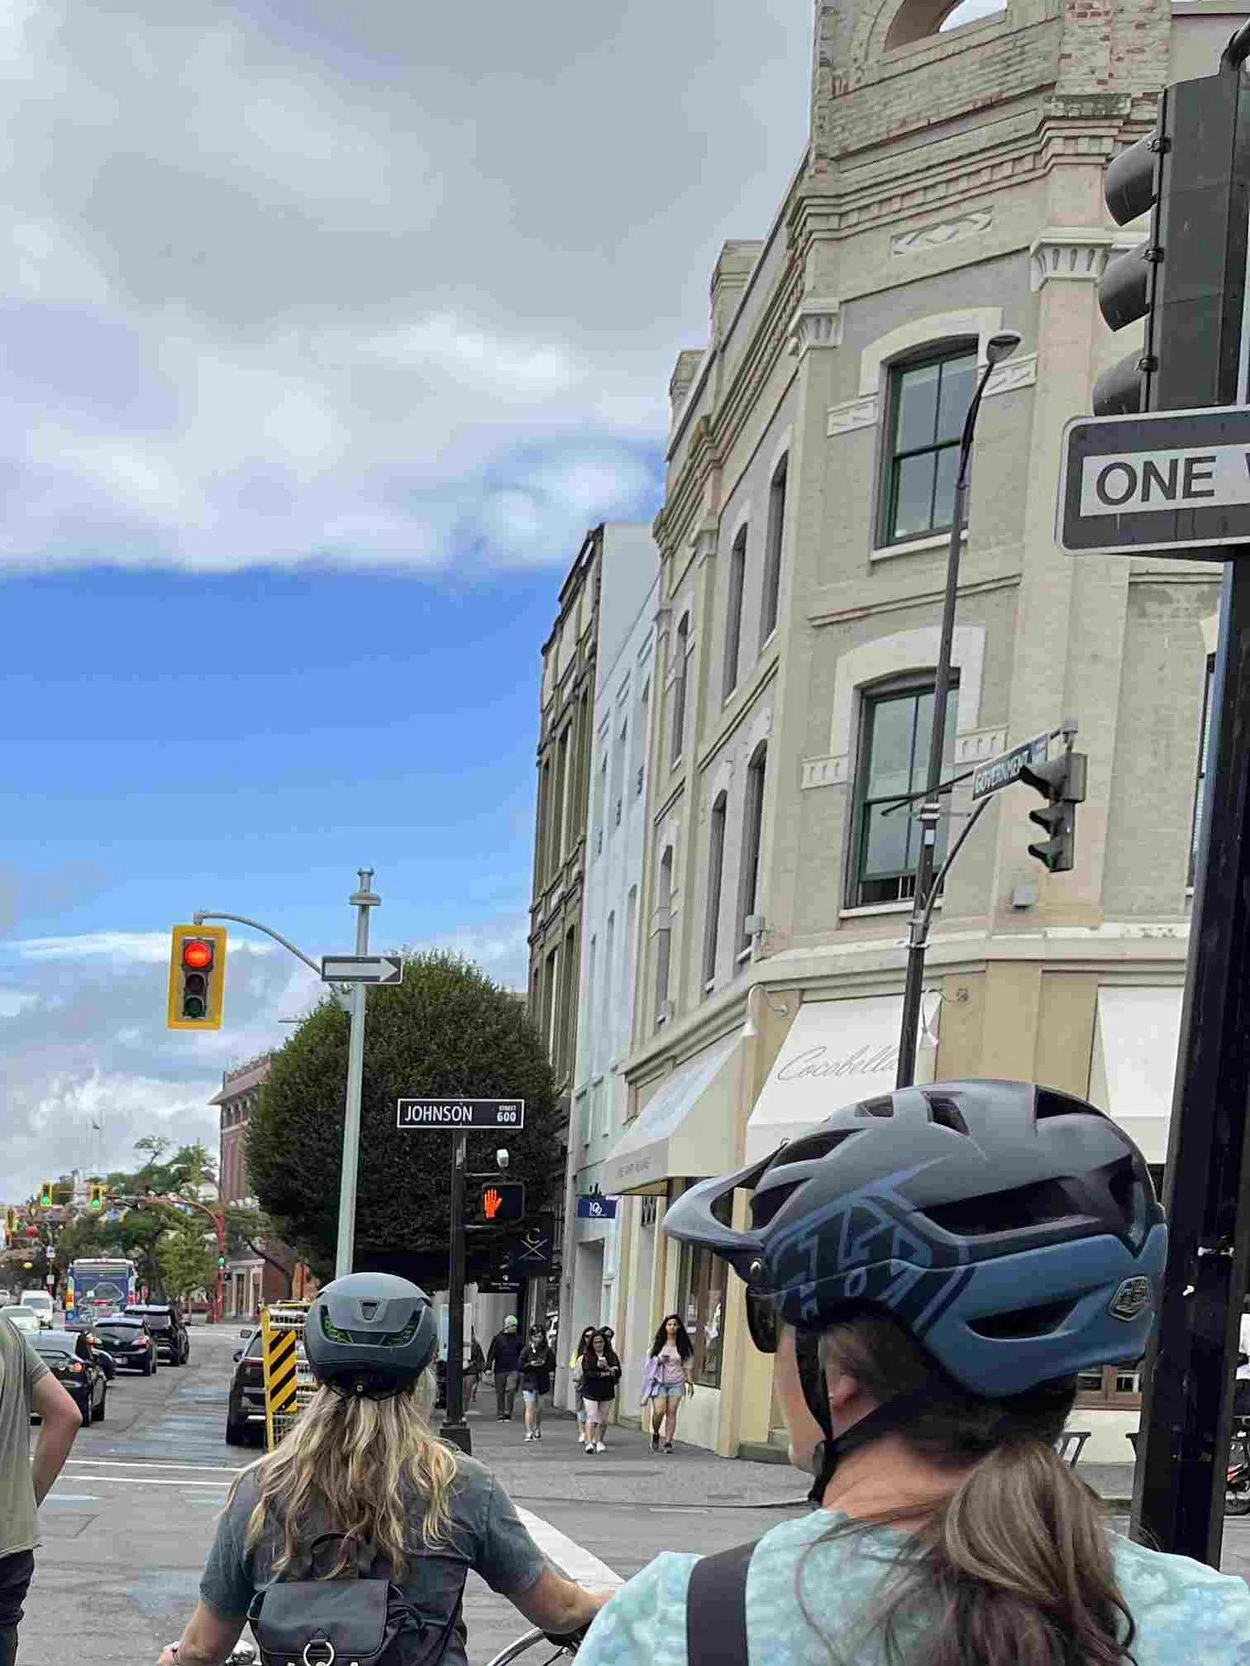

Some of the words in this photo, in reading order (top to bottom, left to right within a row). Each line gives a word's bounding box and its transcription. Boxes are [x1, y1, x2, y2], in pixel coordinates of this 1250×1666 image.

[1096, 456, 1217, 506] ONE
[404, 1104, 473, 1122] JOHNSON
[496, 1111, 517, 1122] 600
